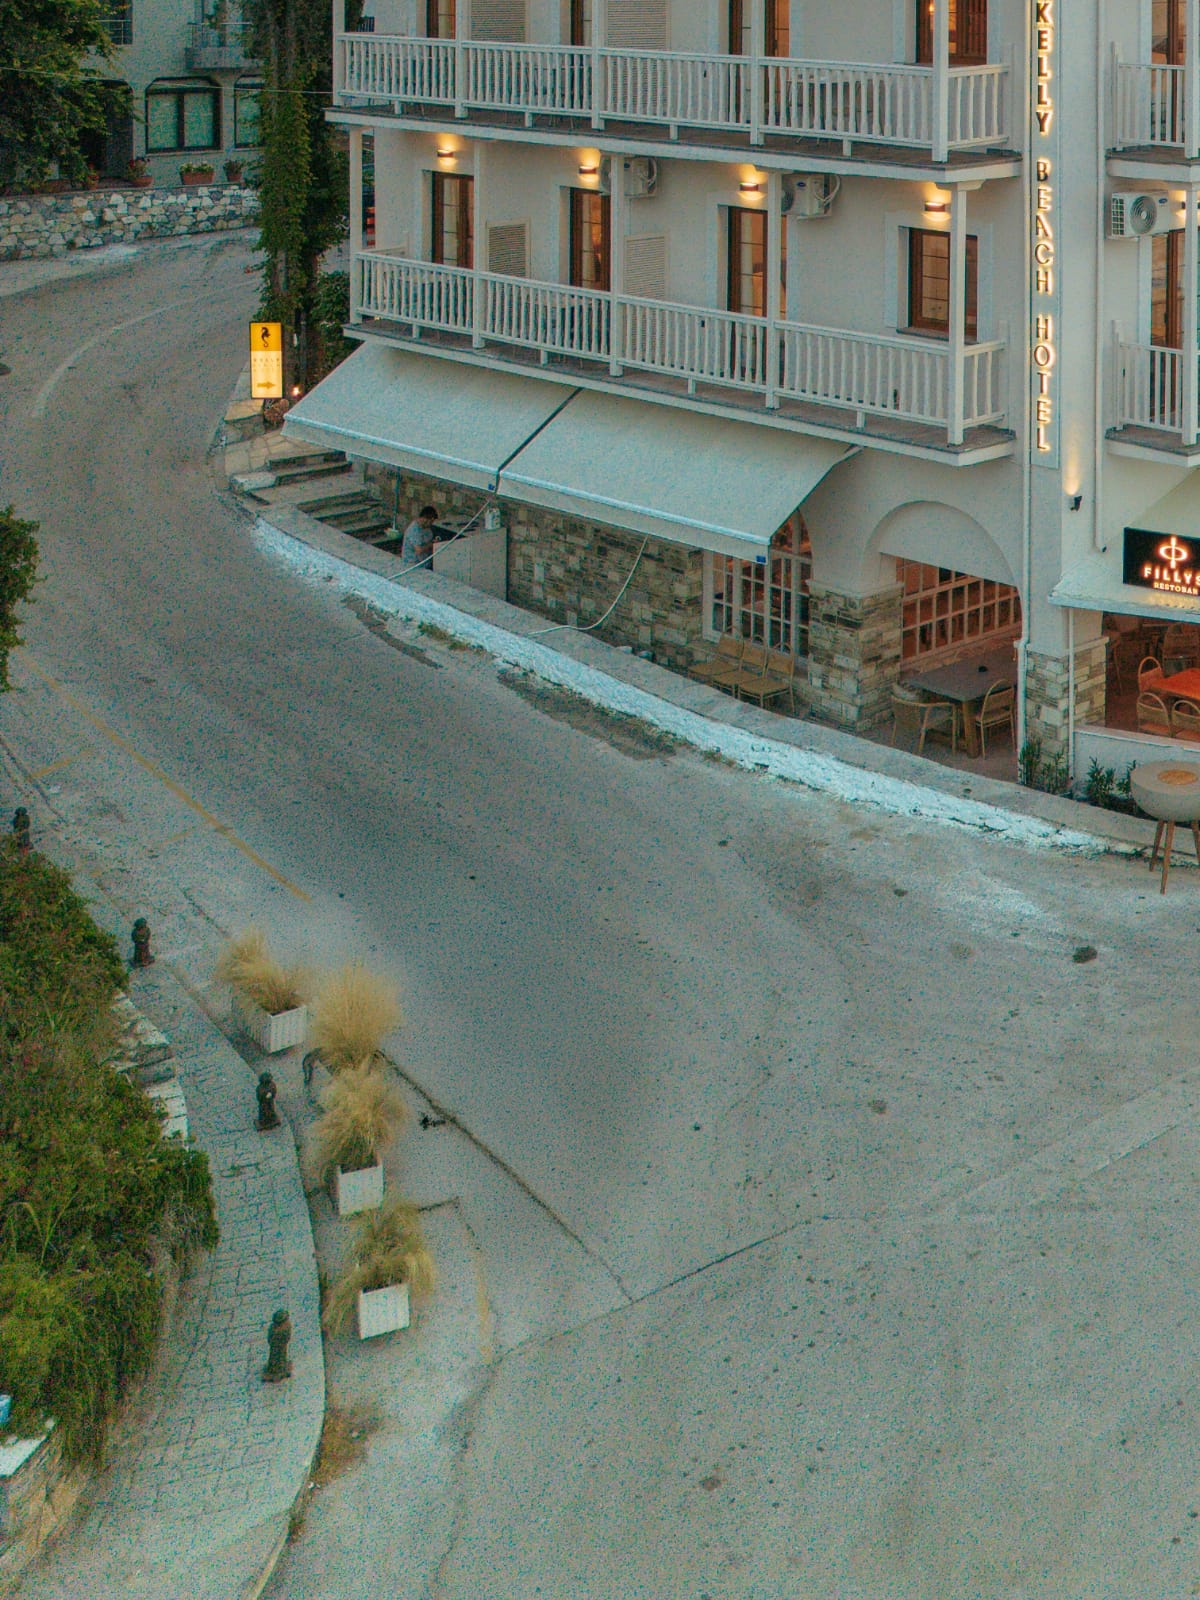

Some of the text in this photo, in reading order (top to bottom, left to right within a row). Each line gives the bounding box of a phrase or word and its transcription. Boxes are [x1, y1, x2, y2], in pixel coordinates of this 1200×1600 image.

[1034, 0, 1055, 451] KELLY BEACH HOTEL
